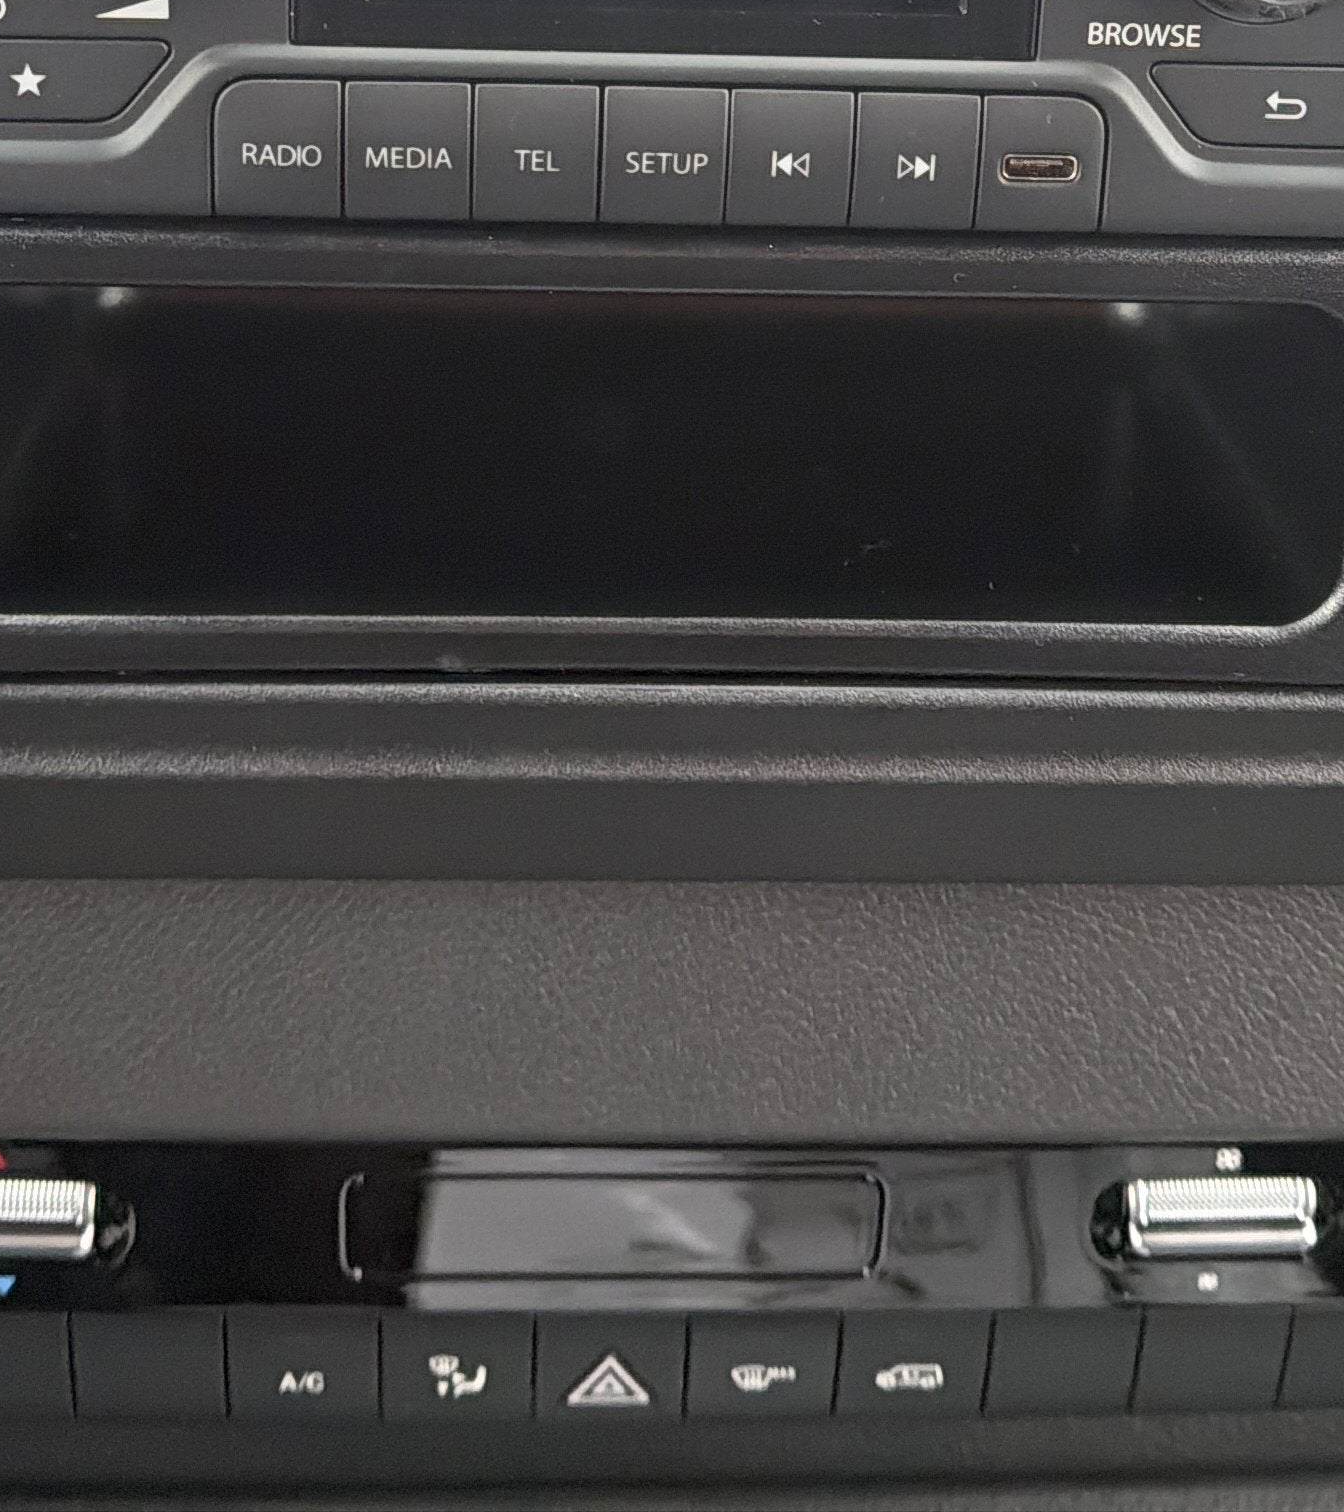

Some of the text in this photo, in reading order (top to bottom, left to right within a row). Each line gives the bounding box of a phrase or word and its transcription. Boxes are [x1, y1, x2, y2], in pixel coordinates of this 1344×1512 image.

[1086, 21, 1203, 48] BROWSE
[241, 142, 323, 168] RADIO
[364, 146, 453, 171] MEDIA
[513, 148, 561, 173] TEL
[625, 151, 709, 176] SETUP
